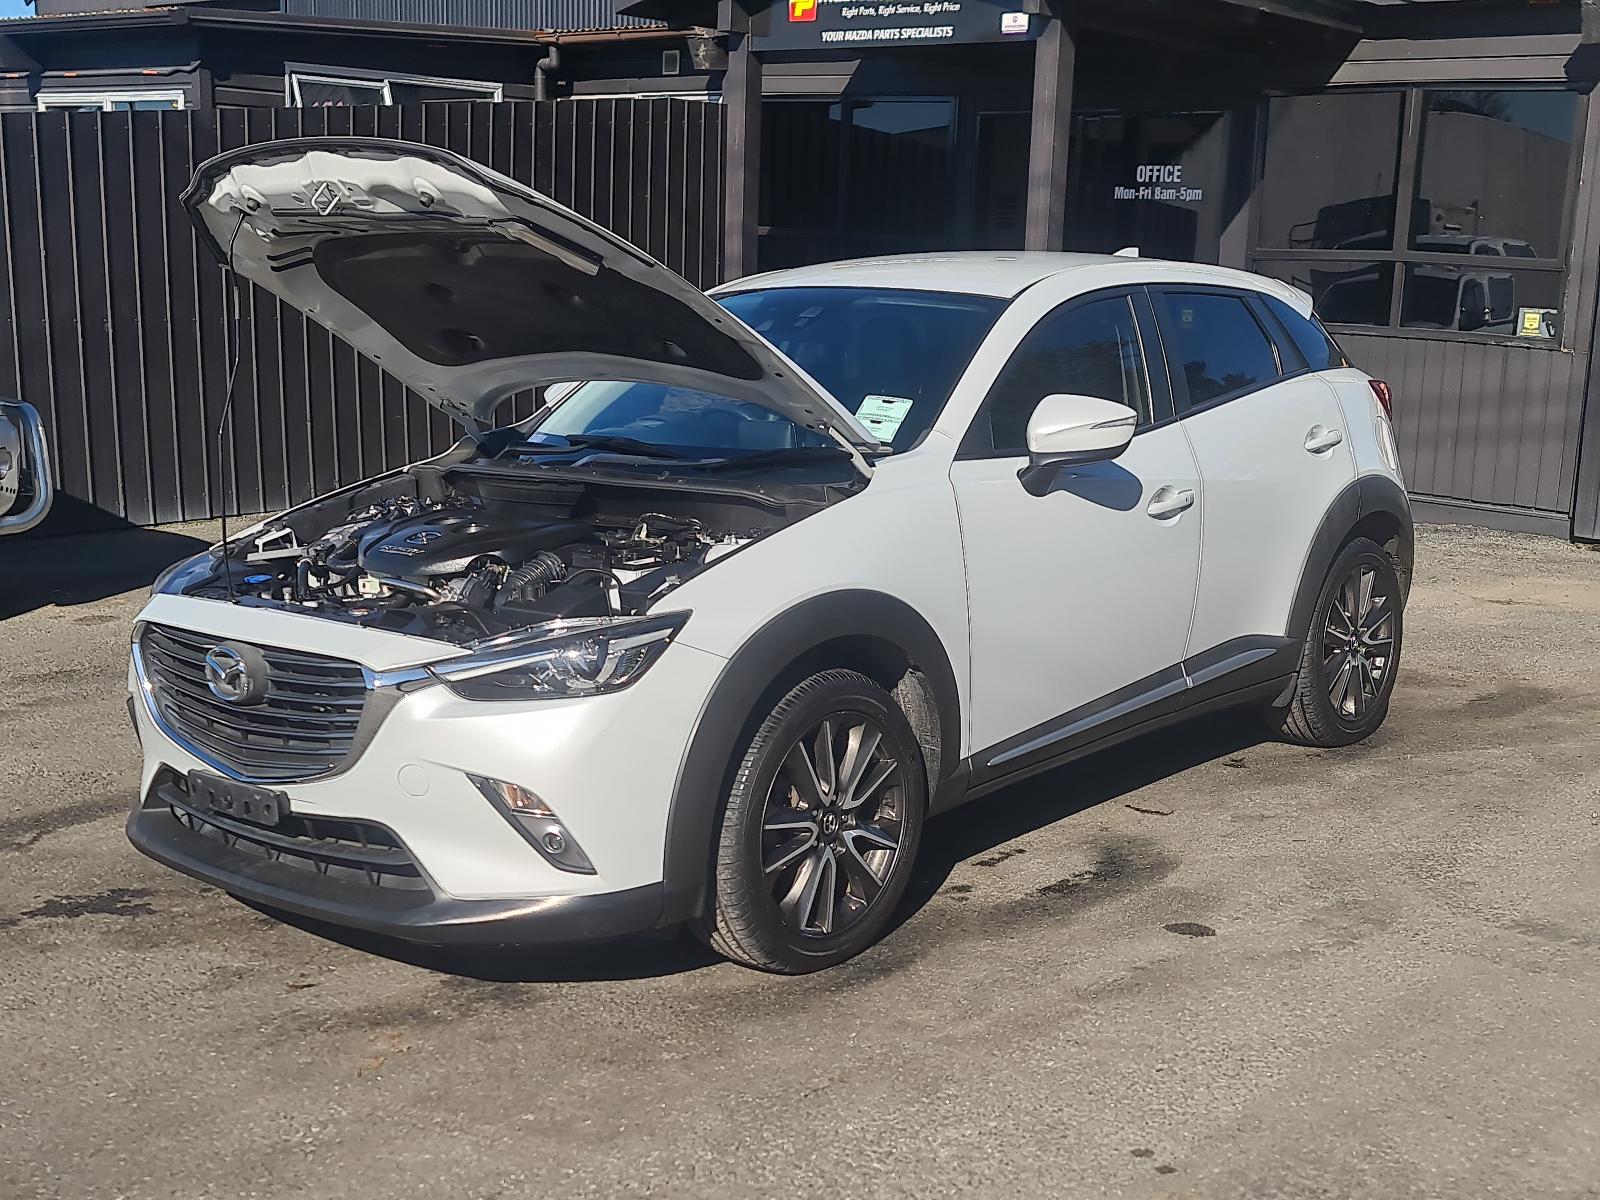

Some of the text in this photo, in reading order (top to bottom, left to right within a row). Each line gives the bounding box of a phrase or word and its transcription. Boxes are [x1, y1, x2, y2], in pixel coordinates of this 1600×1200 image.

[841, 6, 858, 18] Right
[859, 7, 877, 17] Parts,
[878, 5, 895, 17] Right
[896, 4, 922, 15] Service,
[923, 2, 941, 15] Right
[942, 2, 960, 12] Price
[821, 26, 954, 42] YOUR MAZDA PARTS SPECIALISTS
[1136, 165, 1182, 183] OFFICE
[1114, 187, 1203, 201] Mon-Fri 8am-5pm
